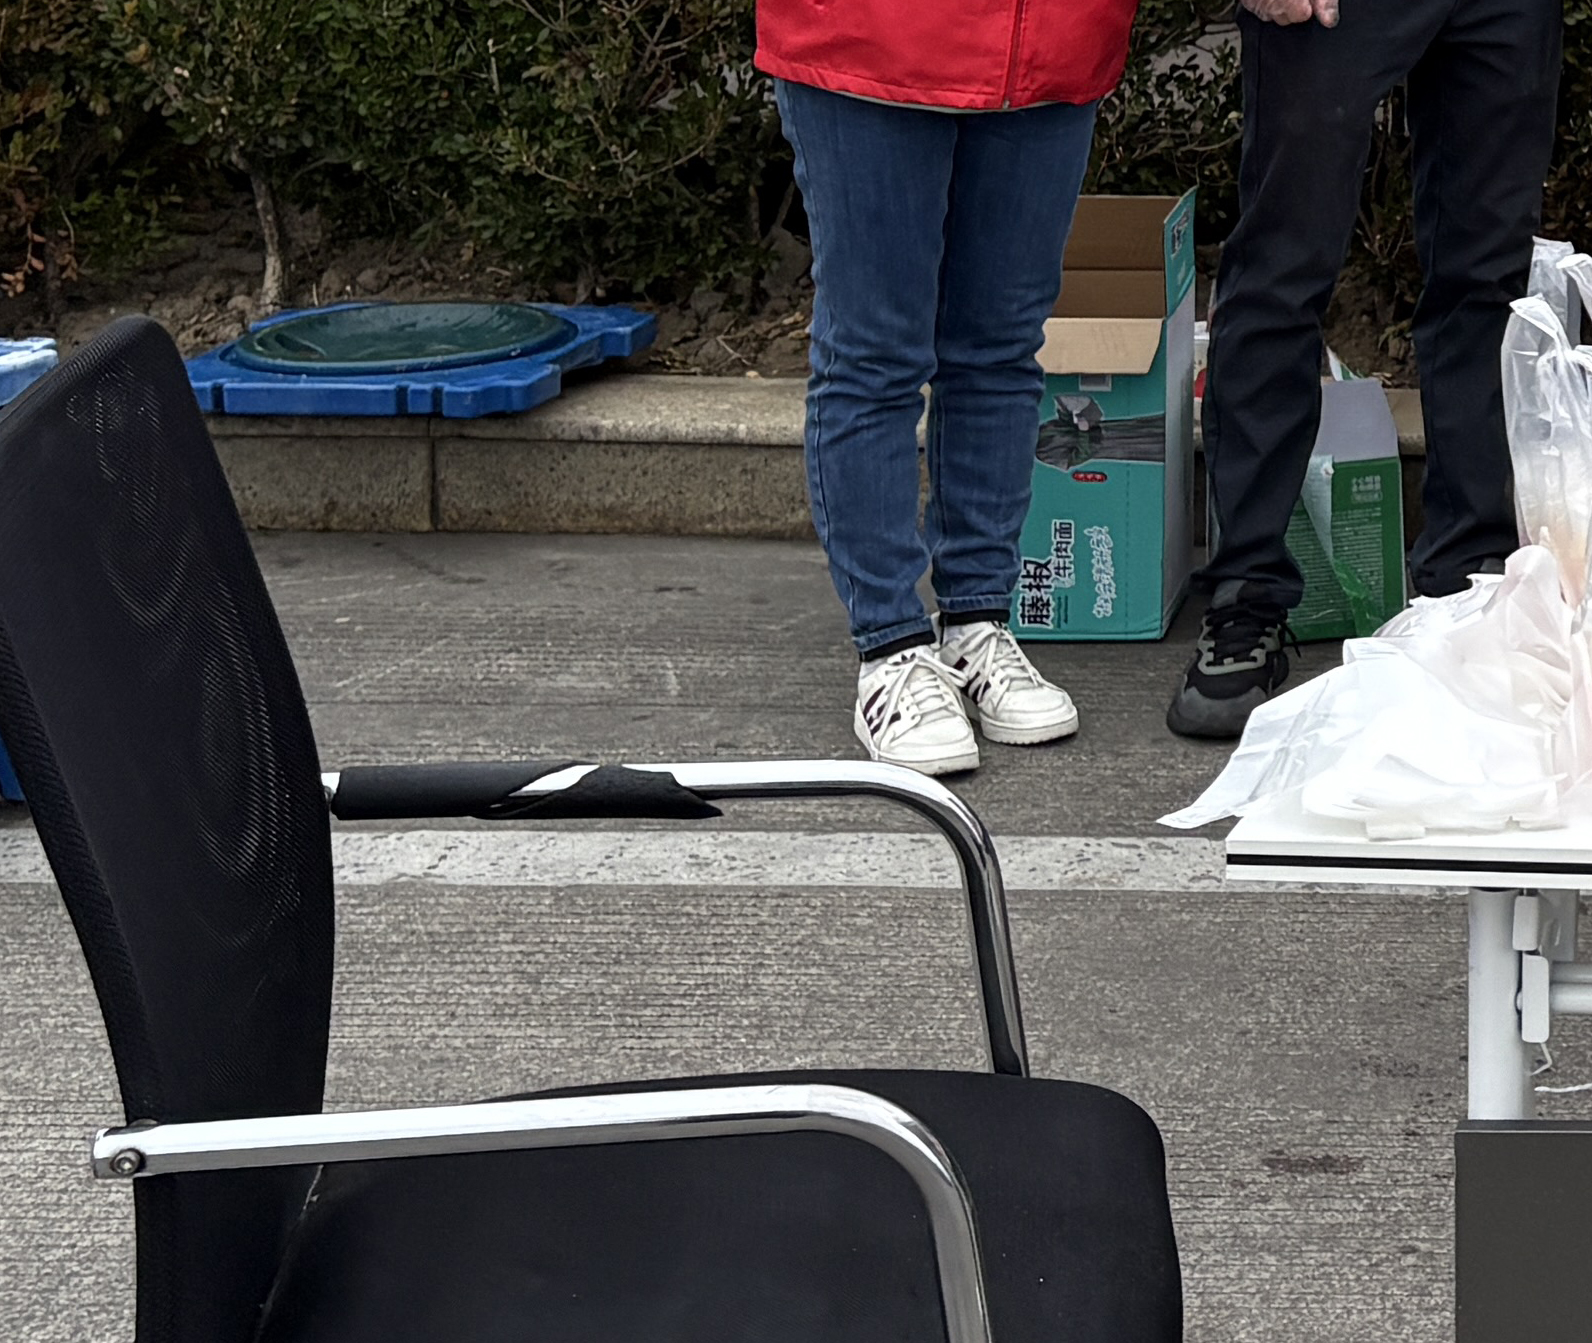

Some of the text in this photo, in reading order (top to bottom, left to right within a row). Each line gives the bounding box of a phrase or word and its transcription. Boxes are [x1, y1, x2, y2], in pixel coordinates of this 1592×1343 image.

[1053, 520, 1073, 578] 牛肉面
[1019, 557, 1054, 627] 藤椒
